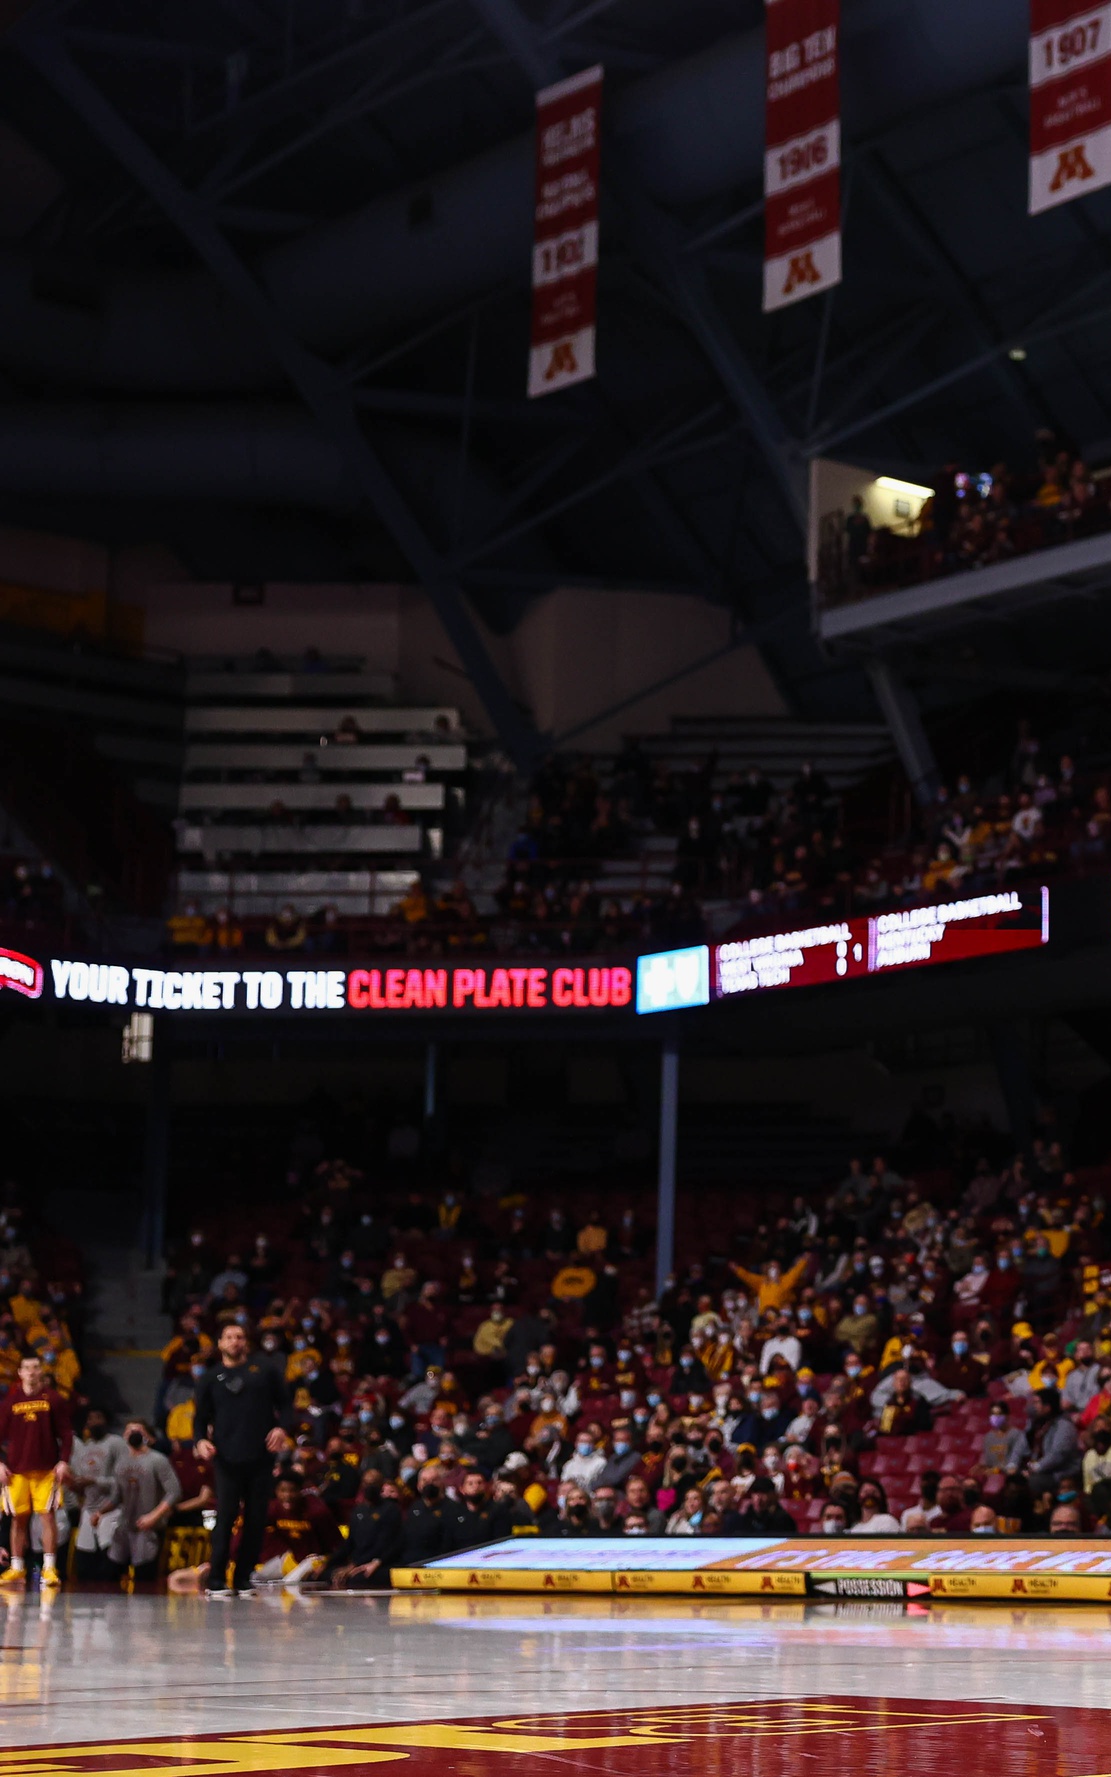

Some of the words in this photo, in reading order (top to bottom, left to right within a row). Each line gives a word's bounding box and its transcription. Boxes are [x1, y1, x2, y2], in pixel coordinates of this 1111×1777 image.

[50, 959, 130, 1005] YOUR
[132, 967, 241, 1010] TICKET
[242, 971, 284, 1009] TO
[286, 971, 345, 1009] THE
[348, 969, 446, 1008] CLEAN
[453, 968, 547, 1008] PLATE
[552, 966, 632, 1007] CLUB
[837, 1578, 904, 1597] POSSESSION
